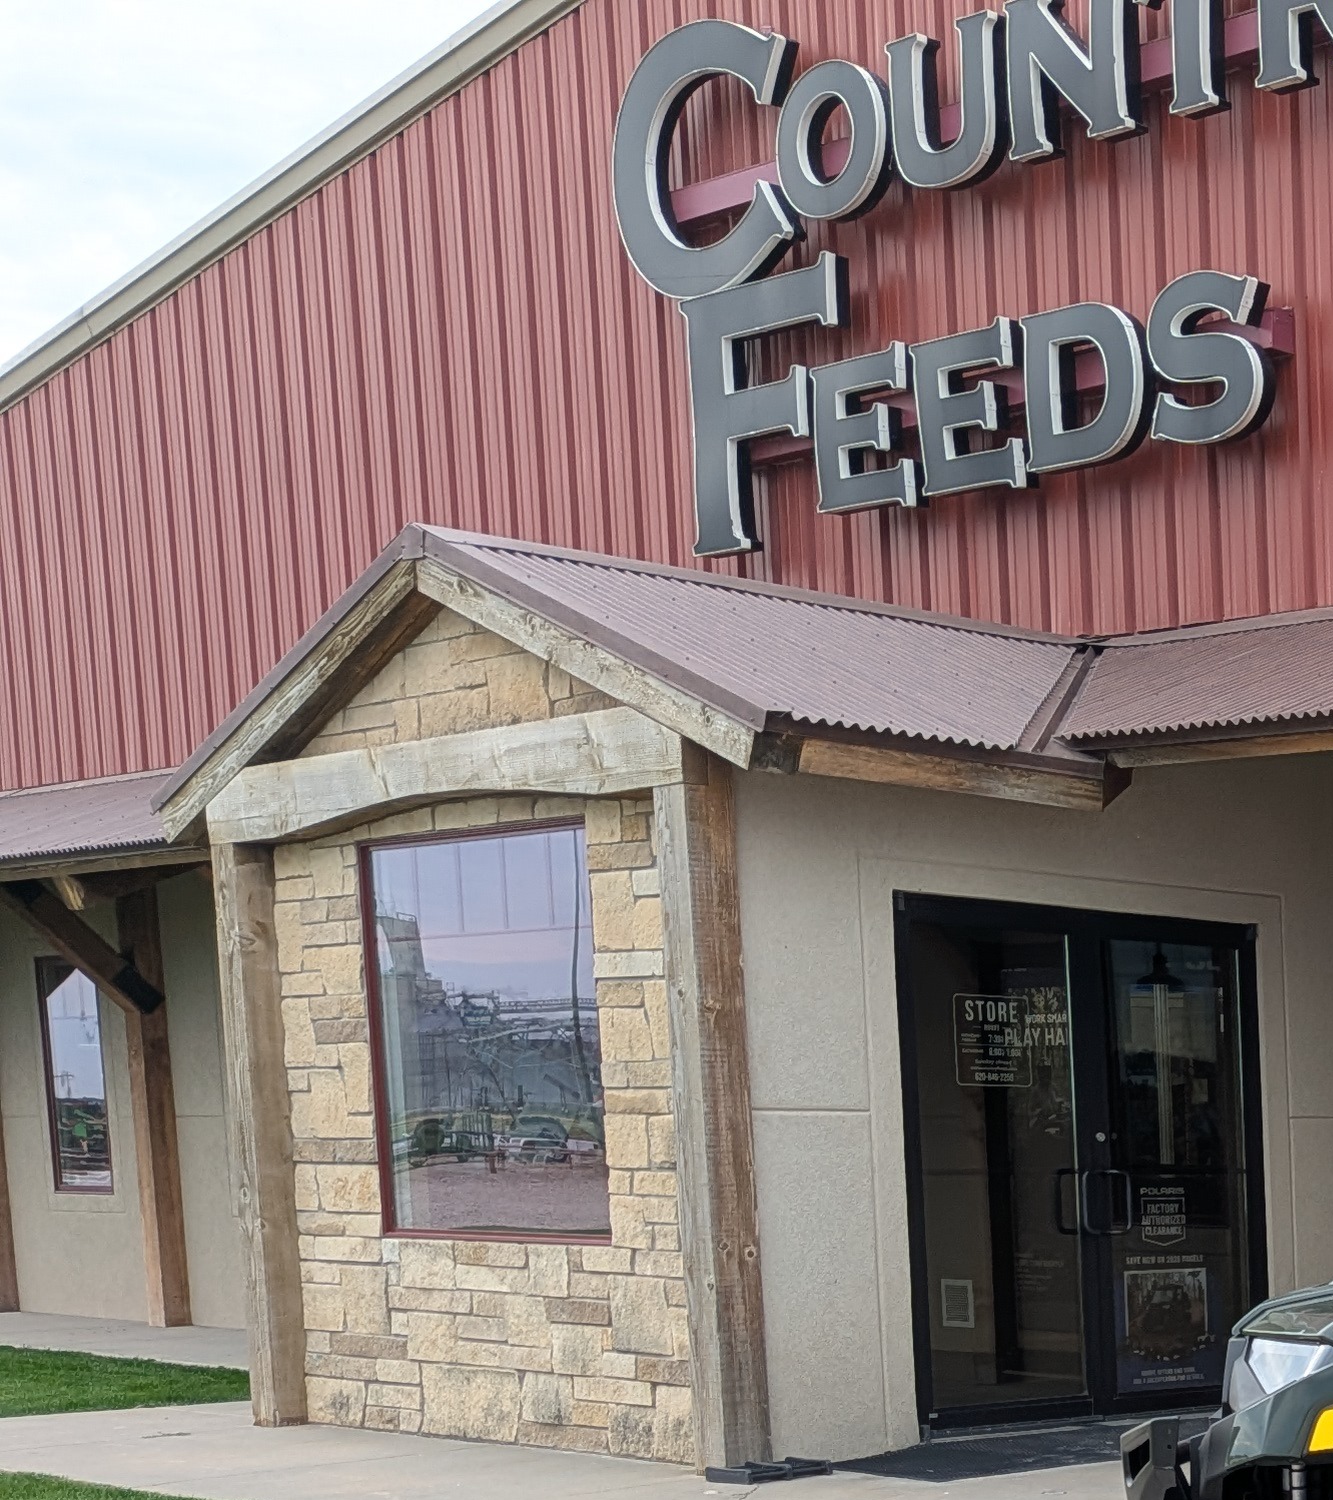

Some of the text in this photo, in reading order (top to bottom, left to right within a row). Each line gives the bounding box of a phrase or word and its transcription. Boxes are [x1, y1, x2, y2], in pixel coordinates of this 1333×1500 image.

[679, 250, 1276, 558] FEEDS
[965, 1000, 1018, 1023] STORE
[1047, 1012, 1067, 1023] SMAR
[1004, 1027, 1041, 1047] PLAY
[1045, 1027, 1068, 1046] HA
[1140, 1187, 1185, 1195] POLARIS
[1147, 1203, 1180, 1214] FACTORY
[1141, 1215, 1186, 1225] AUTHORIZED
[1145, 1226, 1183, 1235] CLEARANCE
